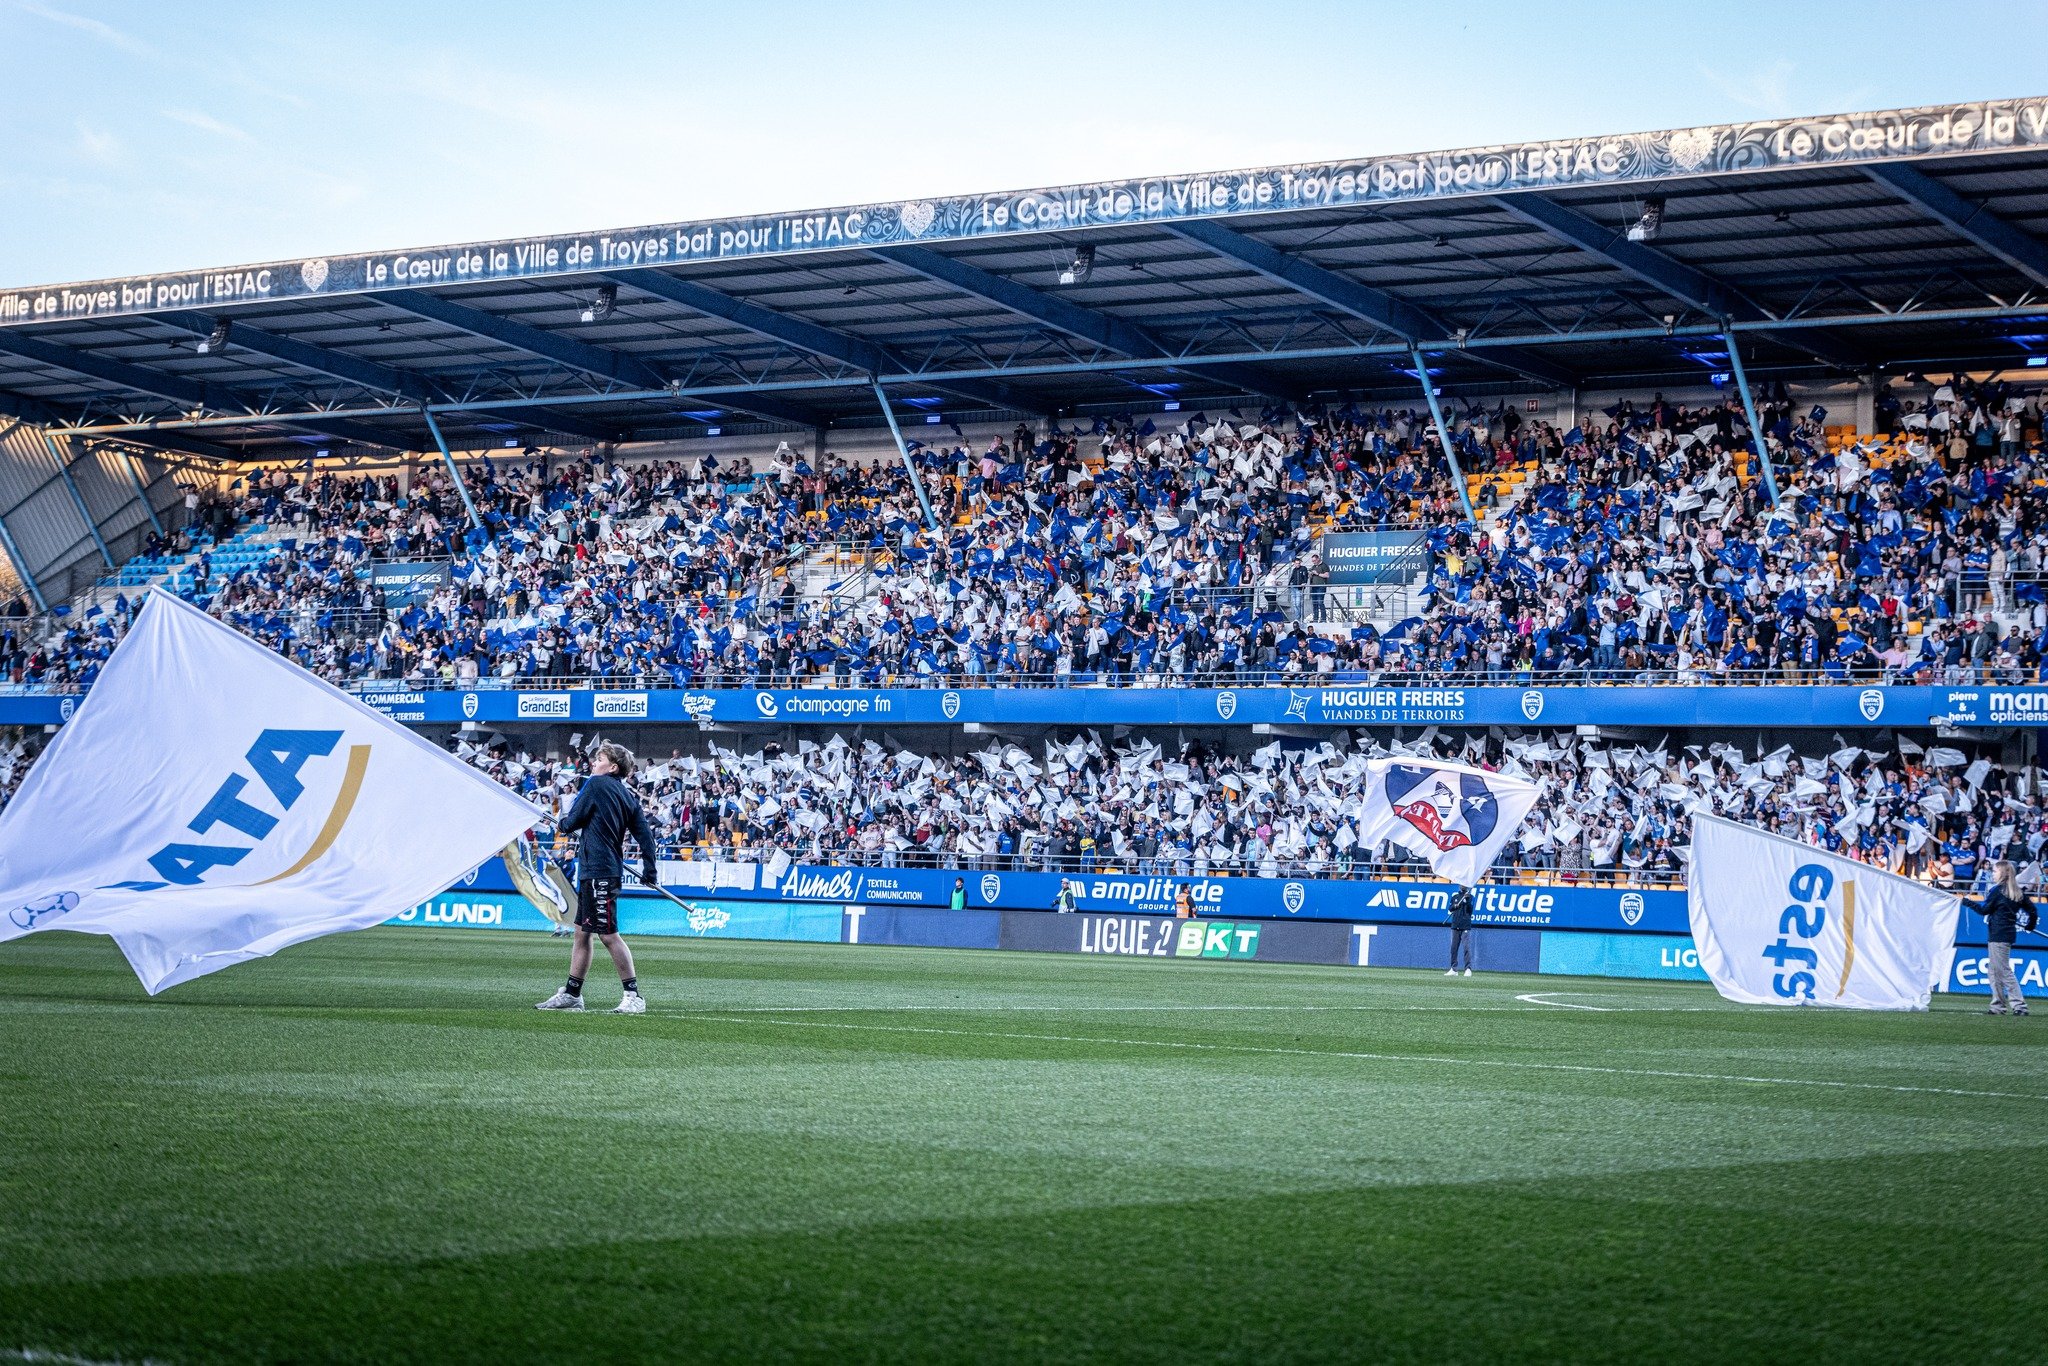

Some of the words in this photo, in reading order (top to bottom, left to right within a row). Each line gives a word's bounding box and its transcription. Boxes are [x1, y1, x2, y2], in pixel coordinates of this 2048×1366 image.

[1777, 128, 1812, 158] Le
[1822, 119, 1916, 154] Cœur
[1928, 114, 1973, 145] de
[1983, 111, 2014, 141] la
[983, 200, 1009, 228] Le
[1016, 194, 1091, 226] Cœur
[1099, 188, 1132, 216] de
[1140, 185, 1164, 213] la
[1173, 179, 1227, 210] Ville
[1239, 175, 1273, 204] de
[1281, 171, 1368, 207] Troyes
[1377, 162, 1426, 192] bat
[1435, 157, 1503, 197] pour
[1510, 142, 1622, 182] l'ESTAC
[366, 260, 387, 283] Le
[393, 254, 450, 280] Cœur
[457, 250, 484, 275] de
[489, 247, 508, 271] la
[515, 243, 559, 269] Ville
[566, 240, 594, 265] de
[600, 236, 668, 264] Troyes
[675, 231, 713, 255] bat
[719, 225, 770, 257] pour
[778, 213, 862, 246] l'ESTAC
[34, 292, 58, 314] de
[61, 289, 117, 315] Troyes
[122, 283, 152, 307] bat
[157, 282, 197, 309] pour
[204, 270, 272, 298] l'ESTAC
[1329, 546, 1378, 559] HUGUIER
[1329, 564, 1364, 572] VIANDES
[1366, 563, 1378, 571] DE
[375, 575, 411, 585] HUGUIER
[365, 694, 425, 704] COMMERCIAL
[1321, 691, 1397, 708] HUGUIER
[1402, 690, 1465, 708] FRERES
[1949, 692, 1979, 703] pierre
[786, 695, 869, 718] champagne
[874, 695, 891, 712] fm
[1959, 702, 1967, 712] &
[1322, 709, 1376, 721] VIANDES
[1381, 709, 1398, 721] DE
[1401, 709, 1464, 721] TERROIRS
[1949, 711, 1977, 722] hervé
[1990, 710, 2048, 724] opticiens
[867, 879, 892, 888] TEXTILE
[893, 880, 899, 888] &
[867, 890, 922, 901] COMMUNICATION
[425, 903, 503, 924] LUNDI
[1171, 905, 1222, 913] AOBILE
[846, 906, 866, 943] T
[1494, 915, 1551, 923] AUTOMOBILE
[1081, 917, 1151, 955] LIGUE
[1153, 920, 1173, 956] 2
[1179, 928, 1257, 953] BKT
[1353, 926, 1377, 966] T
[1661, 948, 1698, 968] LIG
